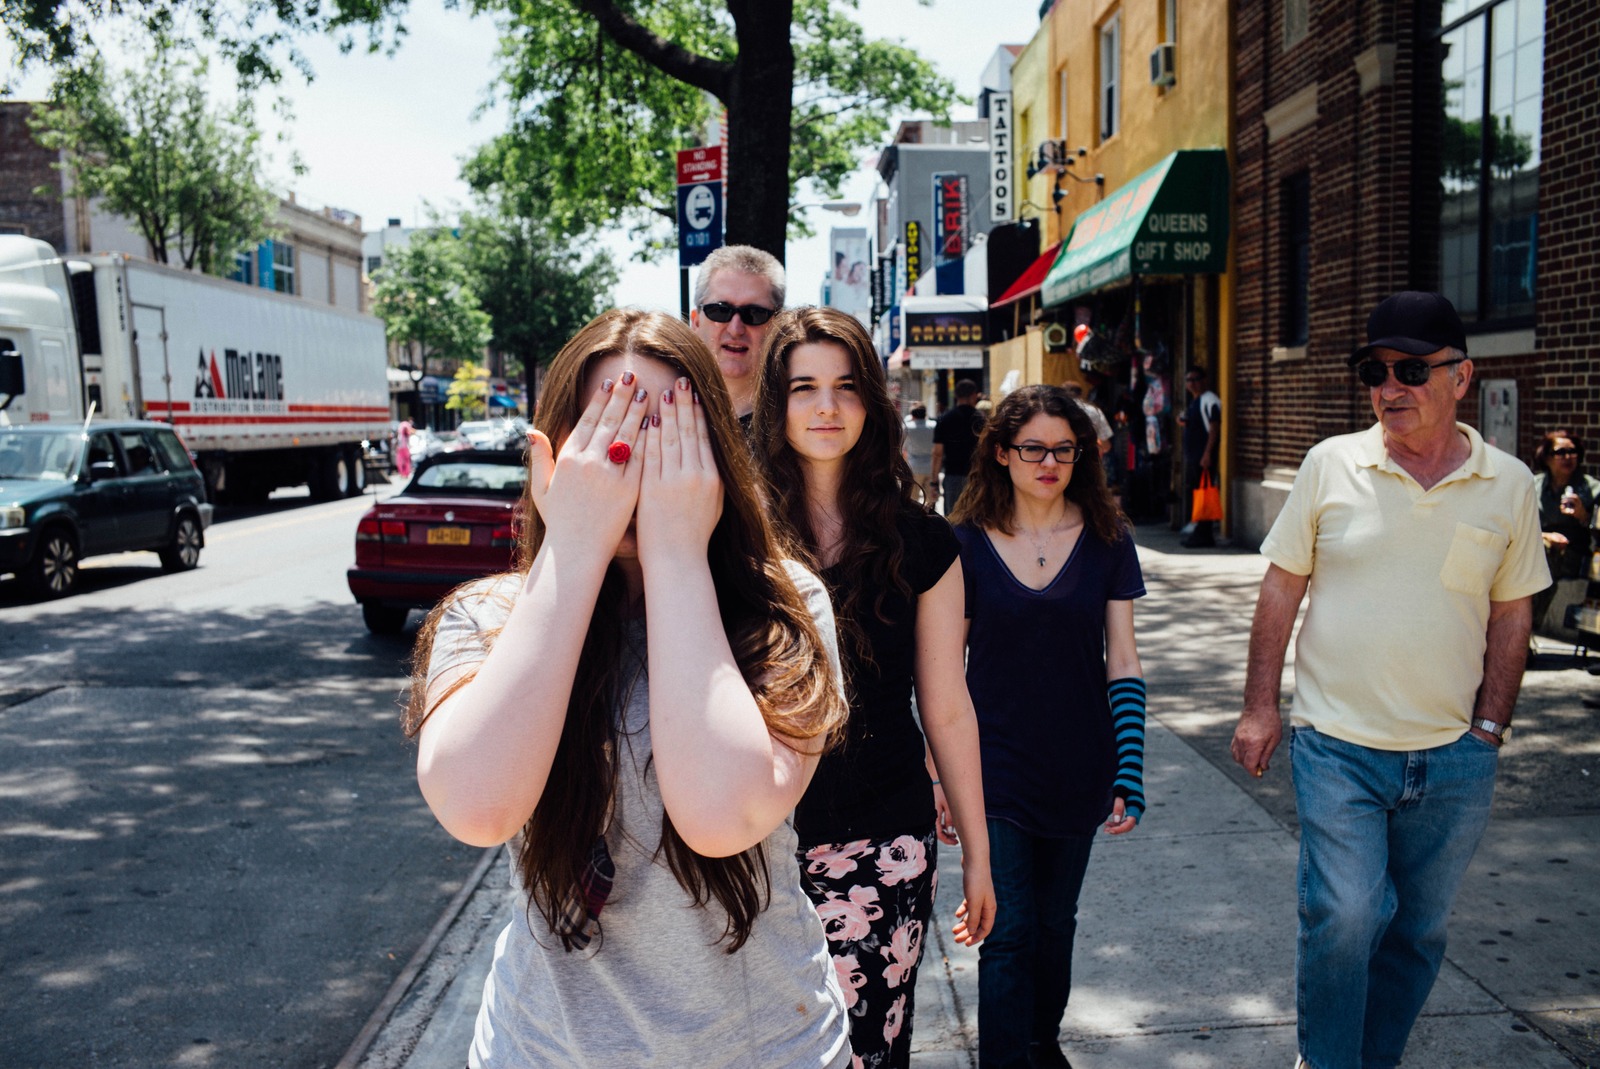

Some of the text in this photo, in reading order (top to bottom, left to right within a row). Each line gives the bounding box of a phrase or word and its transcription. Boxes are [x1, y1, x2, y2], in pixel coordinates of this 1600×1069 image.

[693, 150, 706, 160] NO
[993, 97, 1008, 217] TATTOOS
[682, 159, 718, 174] STANDING
[1148, 213, 1208, 233] QUEENS
[1135, 242, 1211, 261] GIFT SHOP
[910, 324, 983, 342] TATTOO
[193, 400, 250, 413] DISTRIBUTION
